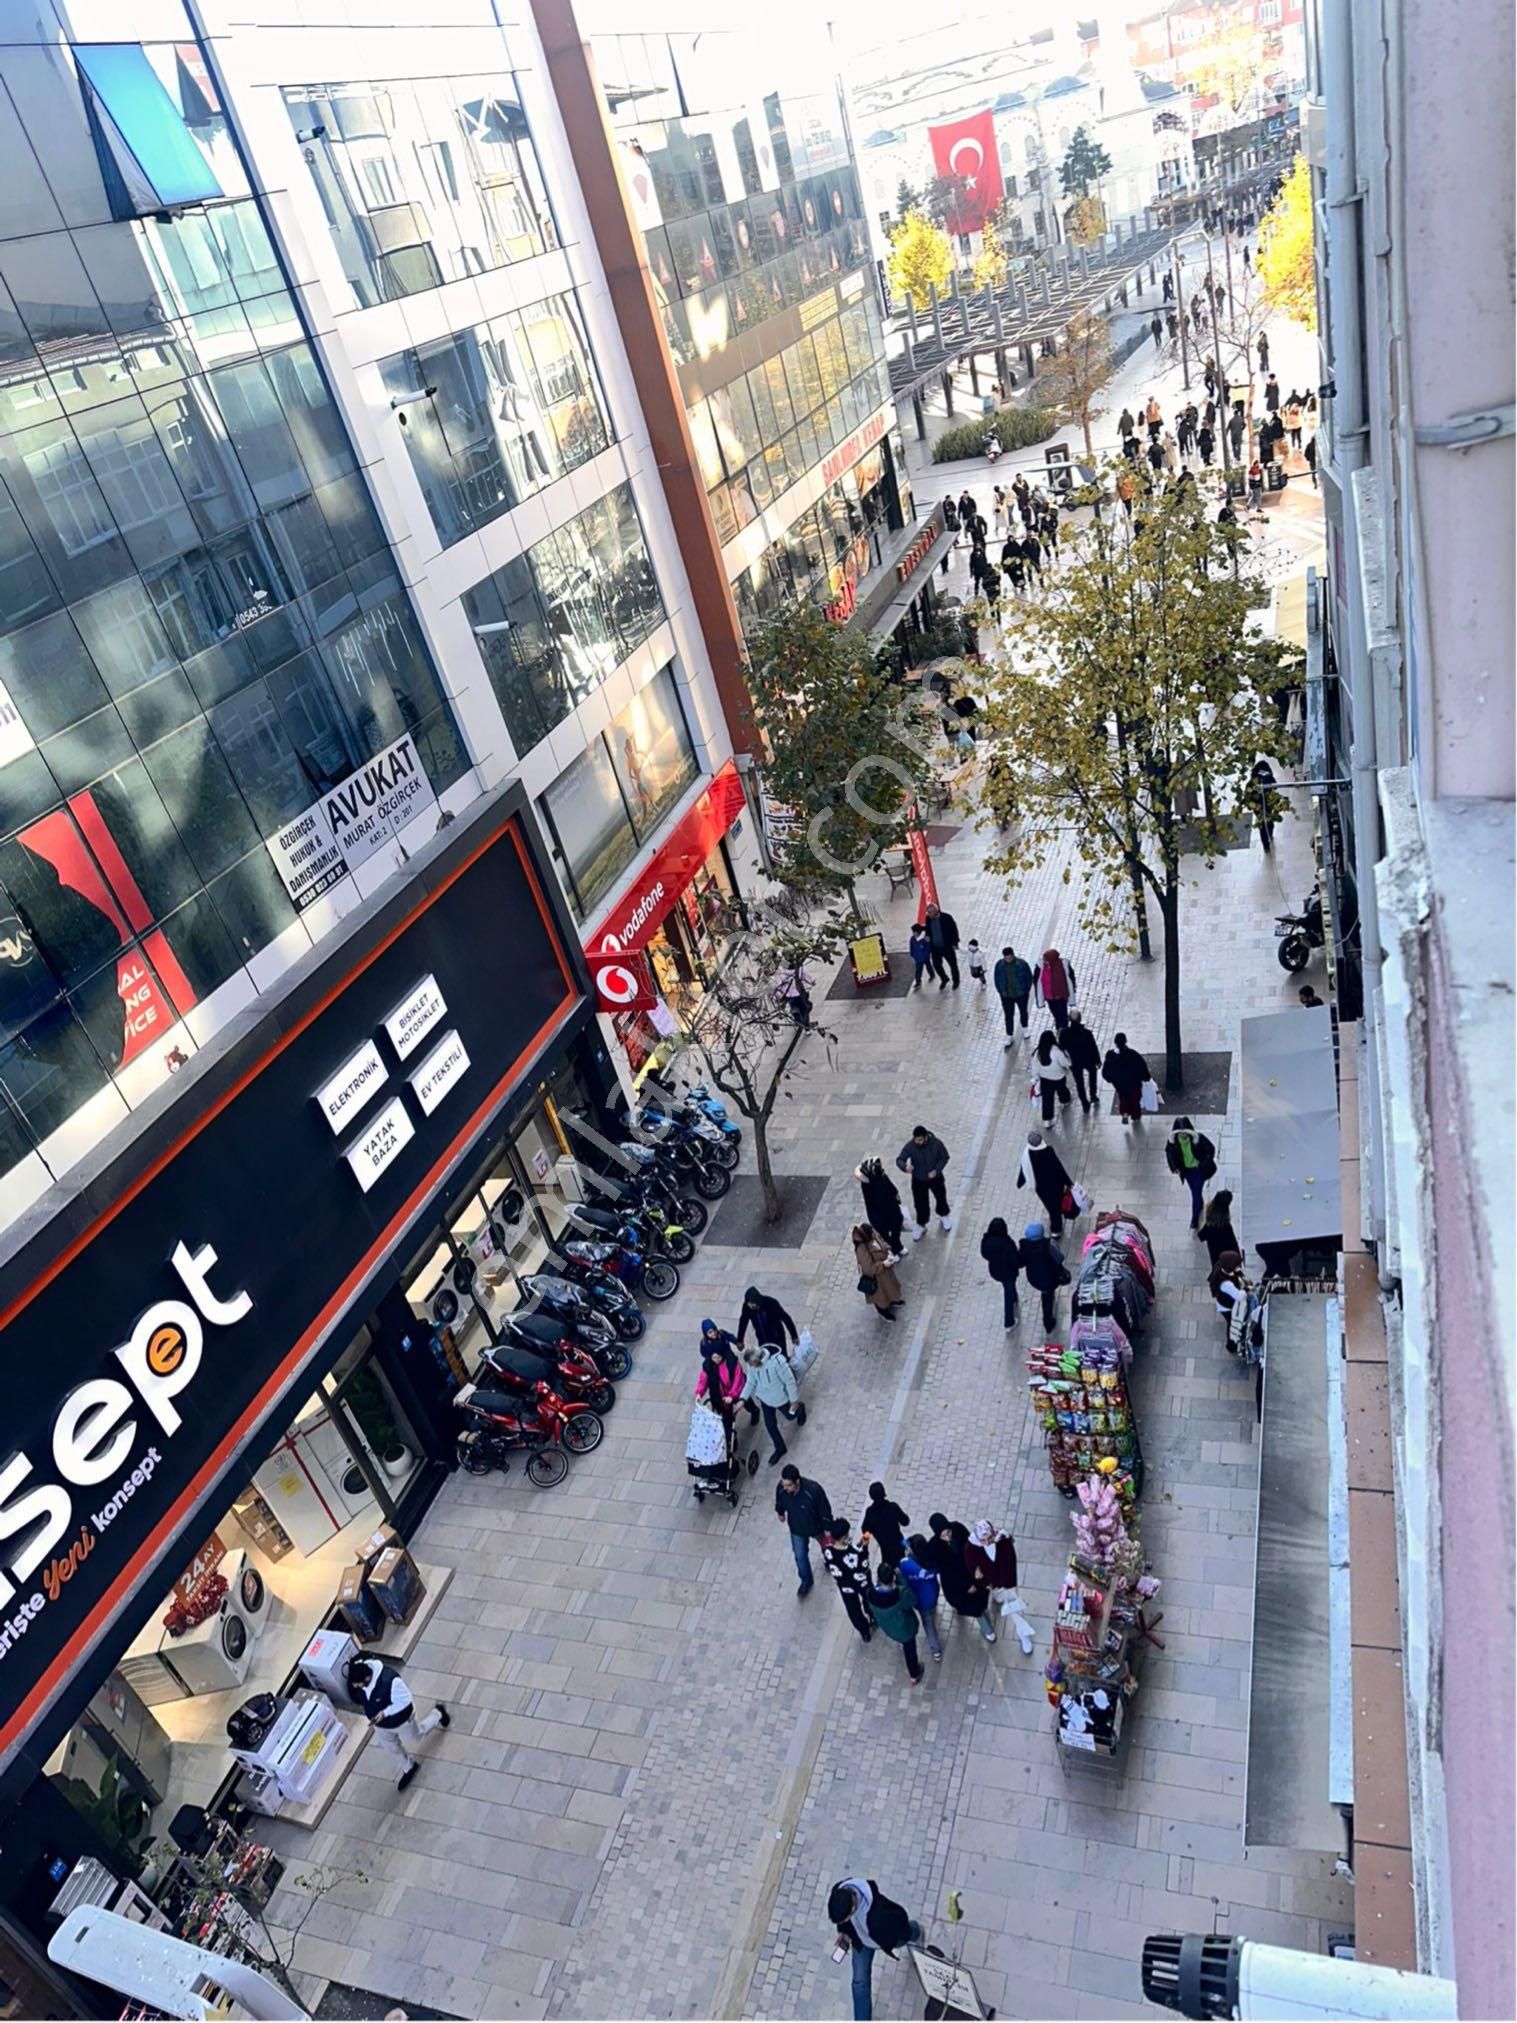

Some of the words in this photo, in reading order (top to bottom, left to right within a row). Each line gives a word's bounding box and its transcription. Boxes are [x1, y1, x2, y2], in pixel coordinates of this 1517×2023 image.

[325, 742, 415, 834] AVUKAT
[343, 816, 376, 850] MURAT
[377, 777, 422, 820] ÖZGİRÇEK
[279, 815, 316, 850] ÖZGİRÇEK
[289, 840, 315, 868] HUKUK
[316, 835, 323, 847] &
[289, 845, 339, 893] DANIŞMANLIK
[619, 881, 665, 946] vodafone
[329, 1058, 379, 1116] ELEKTRONİK
[421, 1083, 433, 1099] EV
[430, 1046, 462, 1086] TEKSTİLİ
[363, 1118, 395, 1155] YATAK
[372, 1135, 398, 1166] BAZA
[0, 1240, 253, 1612] sept
[91, 1445, 163, 1533] konsept
[180, 1555, 205, 1593] 24
[203, 1543, 216, 1563] AY
